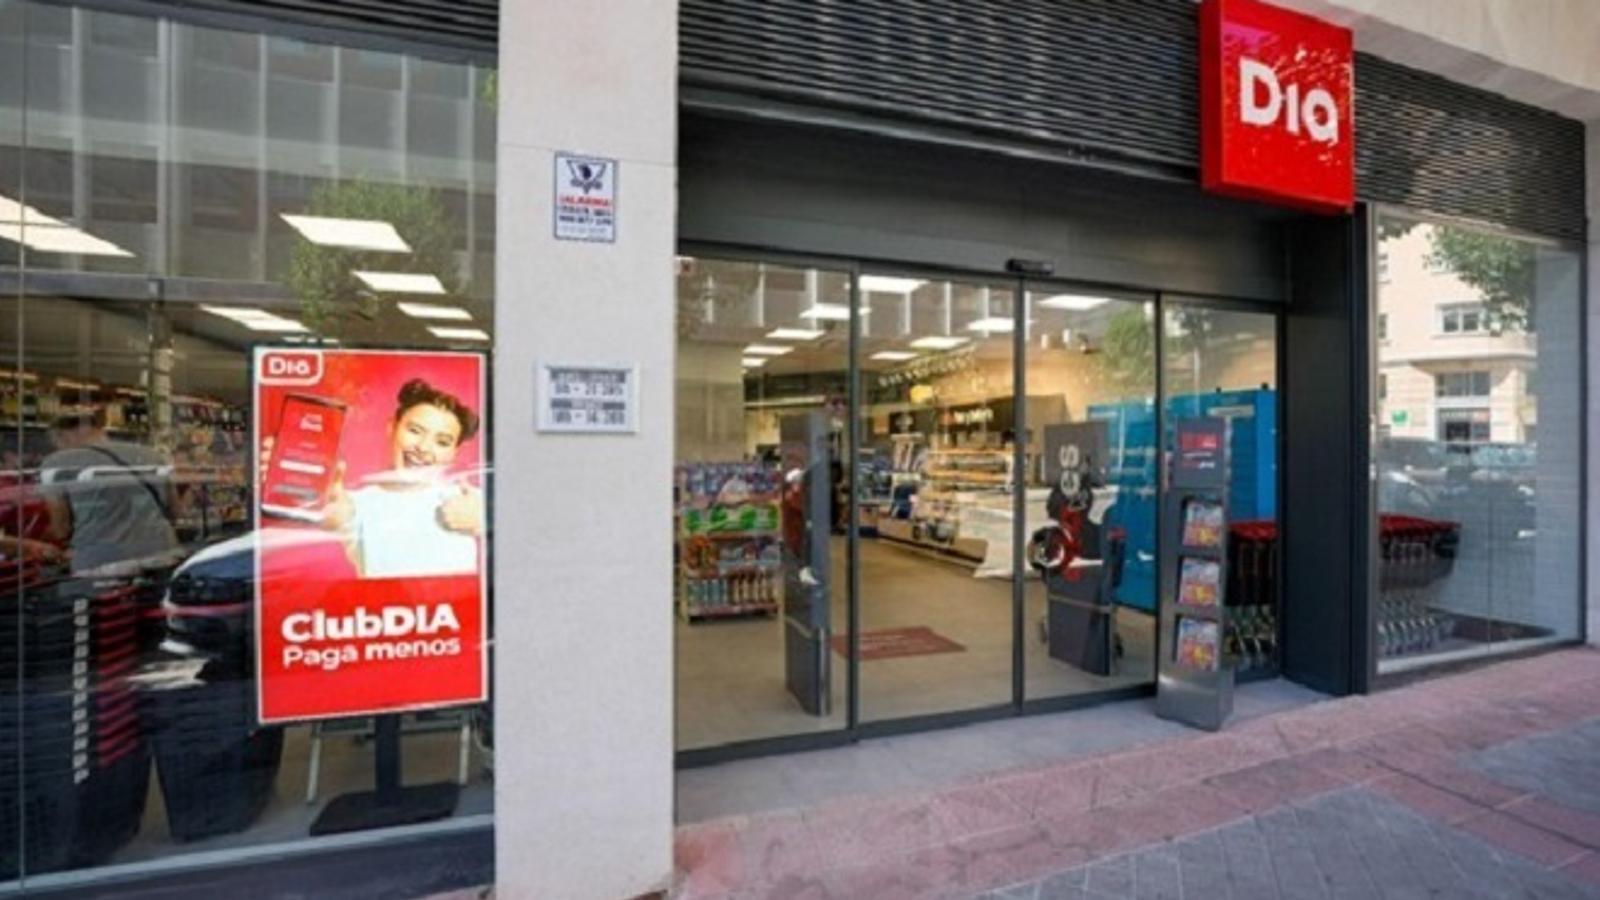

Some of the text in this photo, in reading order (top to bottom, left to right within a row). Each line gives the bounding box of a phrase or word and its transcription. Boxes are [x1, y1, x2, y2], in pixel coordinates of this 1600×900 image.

[281, 603, 460, 643] ClubDIA
[283, 637, 461, 670] Paga menos
